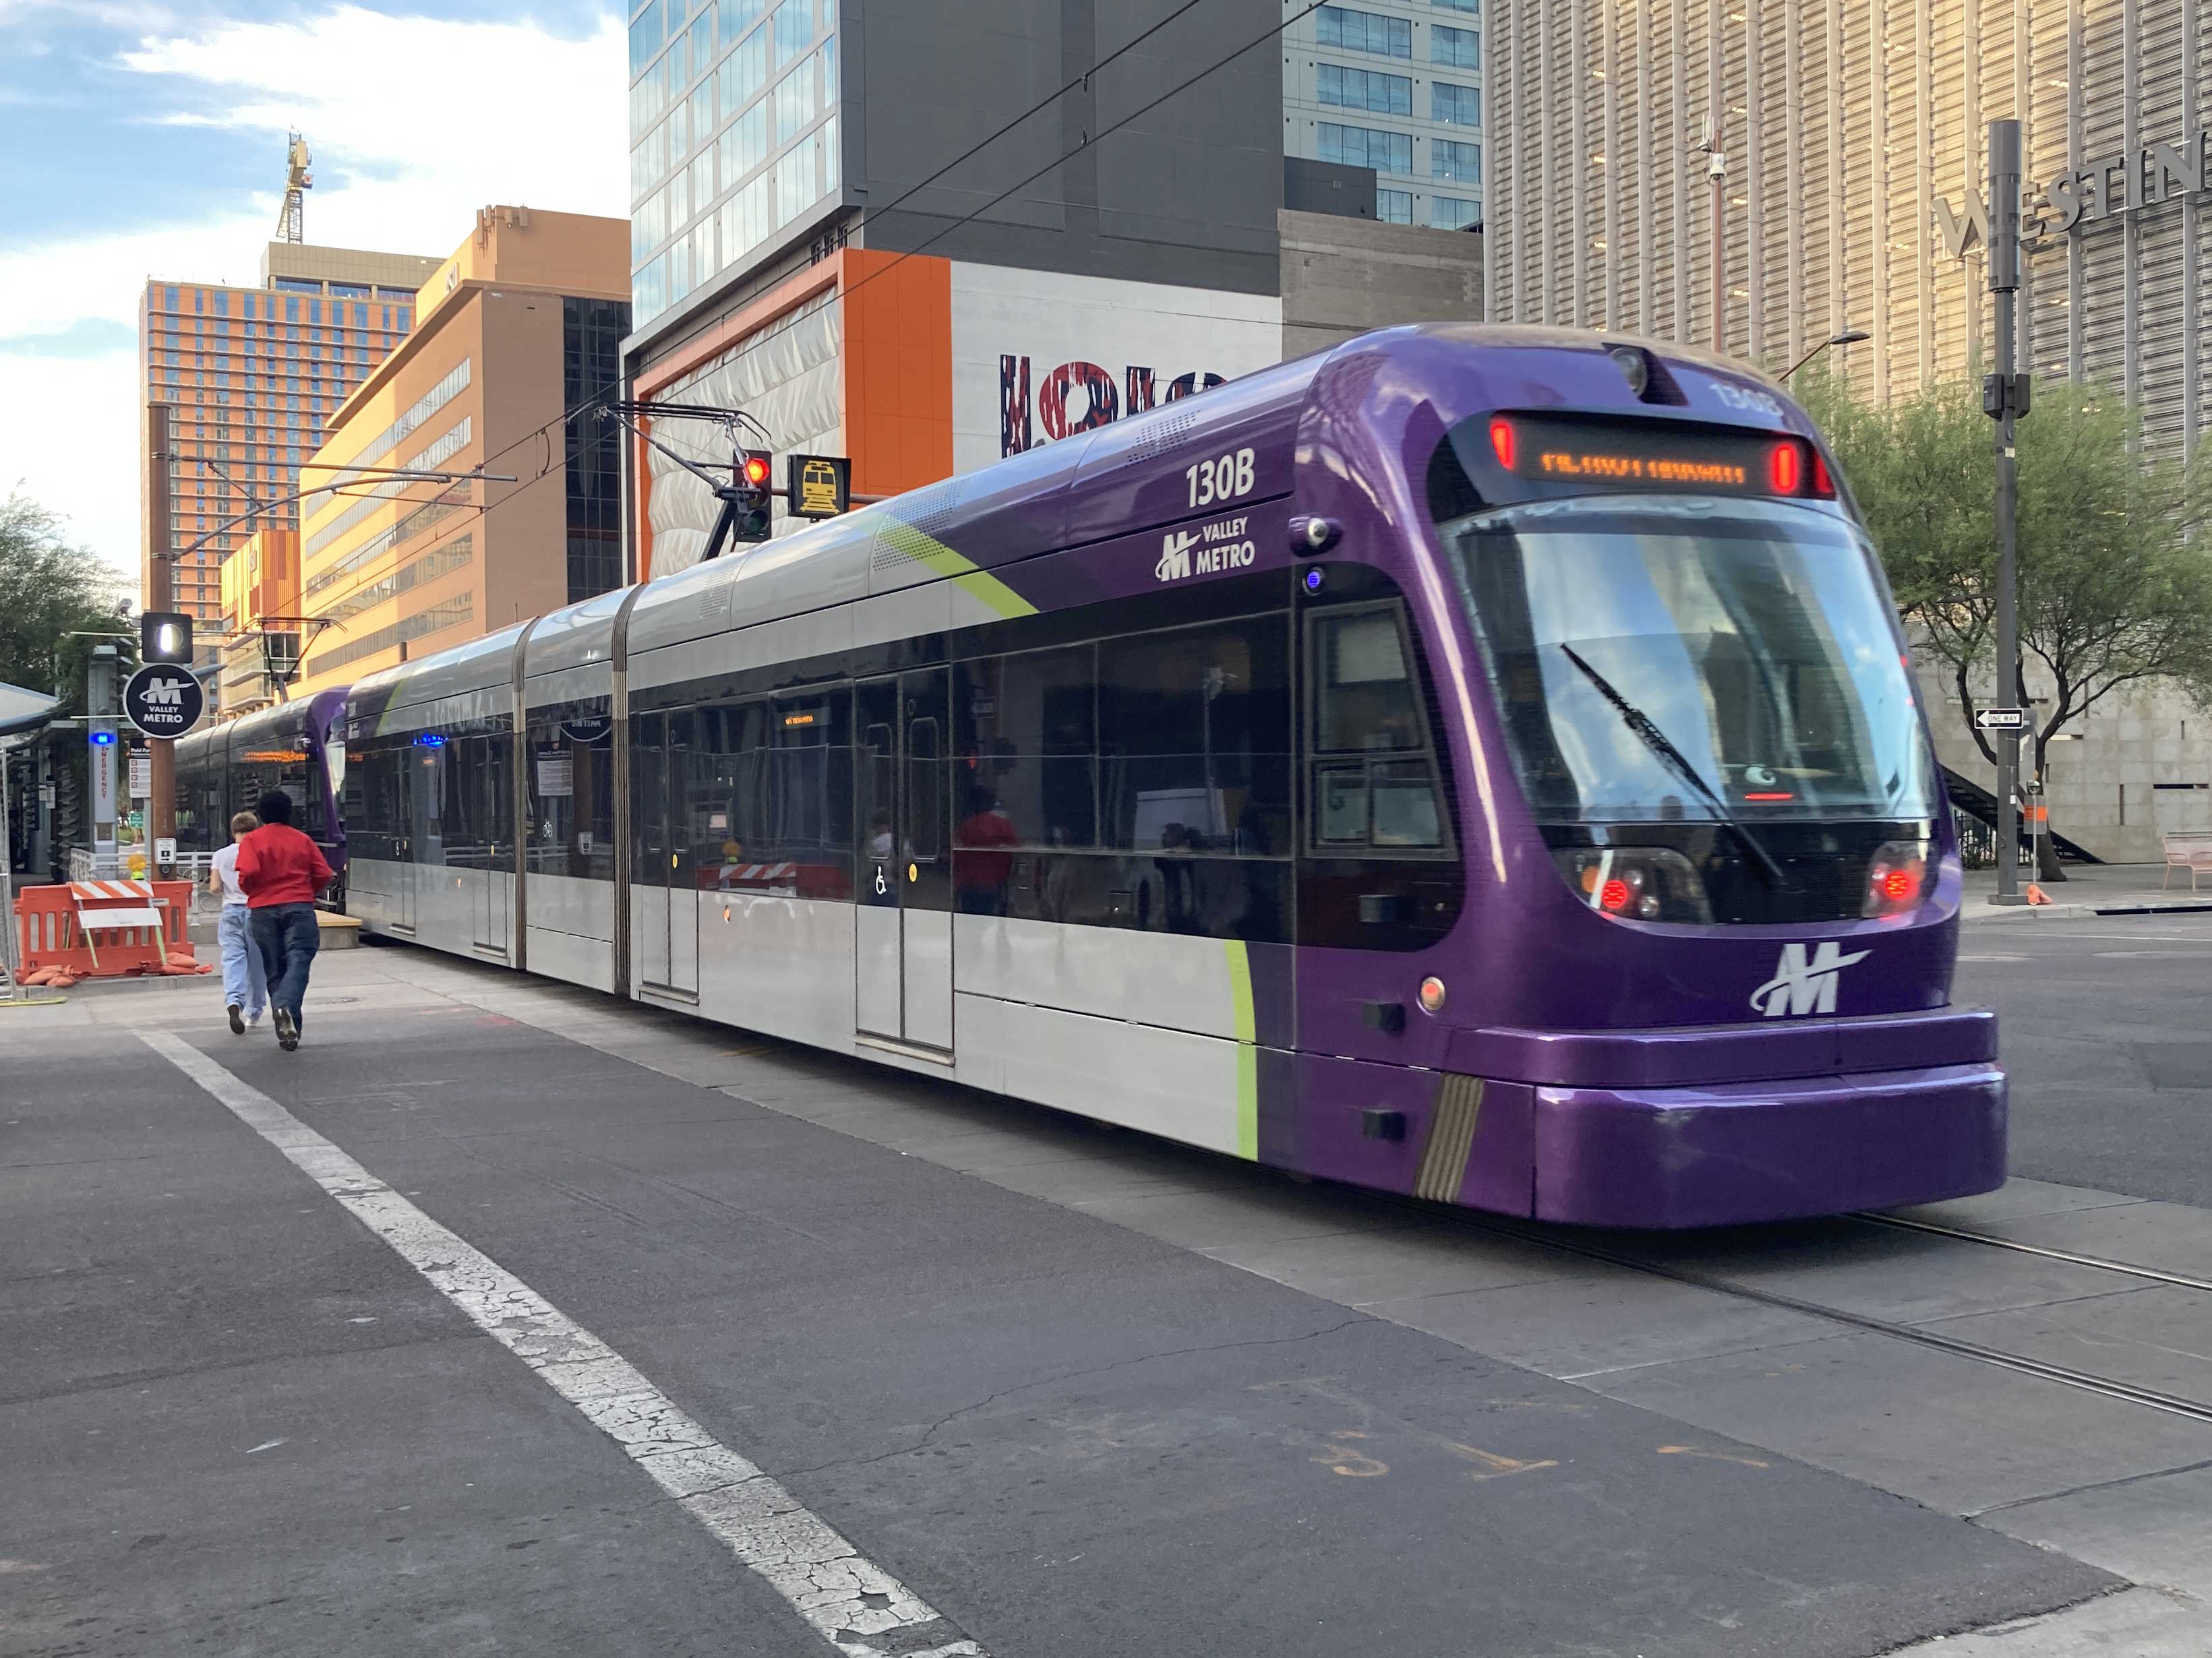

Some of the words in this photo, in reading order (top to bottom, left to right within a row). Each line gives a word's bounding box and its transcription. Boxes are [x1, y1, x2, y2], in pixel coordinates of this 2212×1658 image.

[1931, 131, 2207, 259] WESTIN
[1186, 448, 1255, 508] 130B
[1202, 516, 1249, 543] VALLEY
[1195, 541, 1255, 575] METRO
[143, 714, 183, 723] METRO
